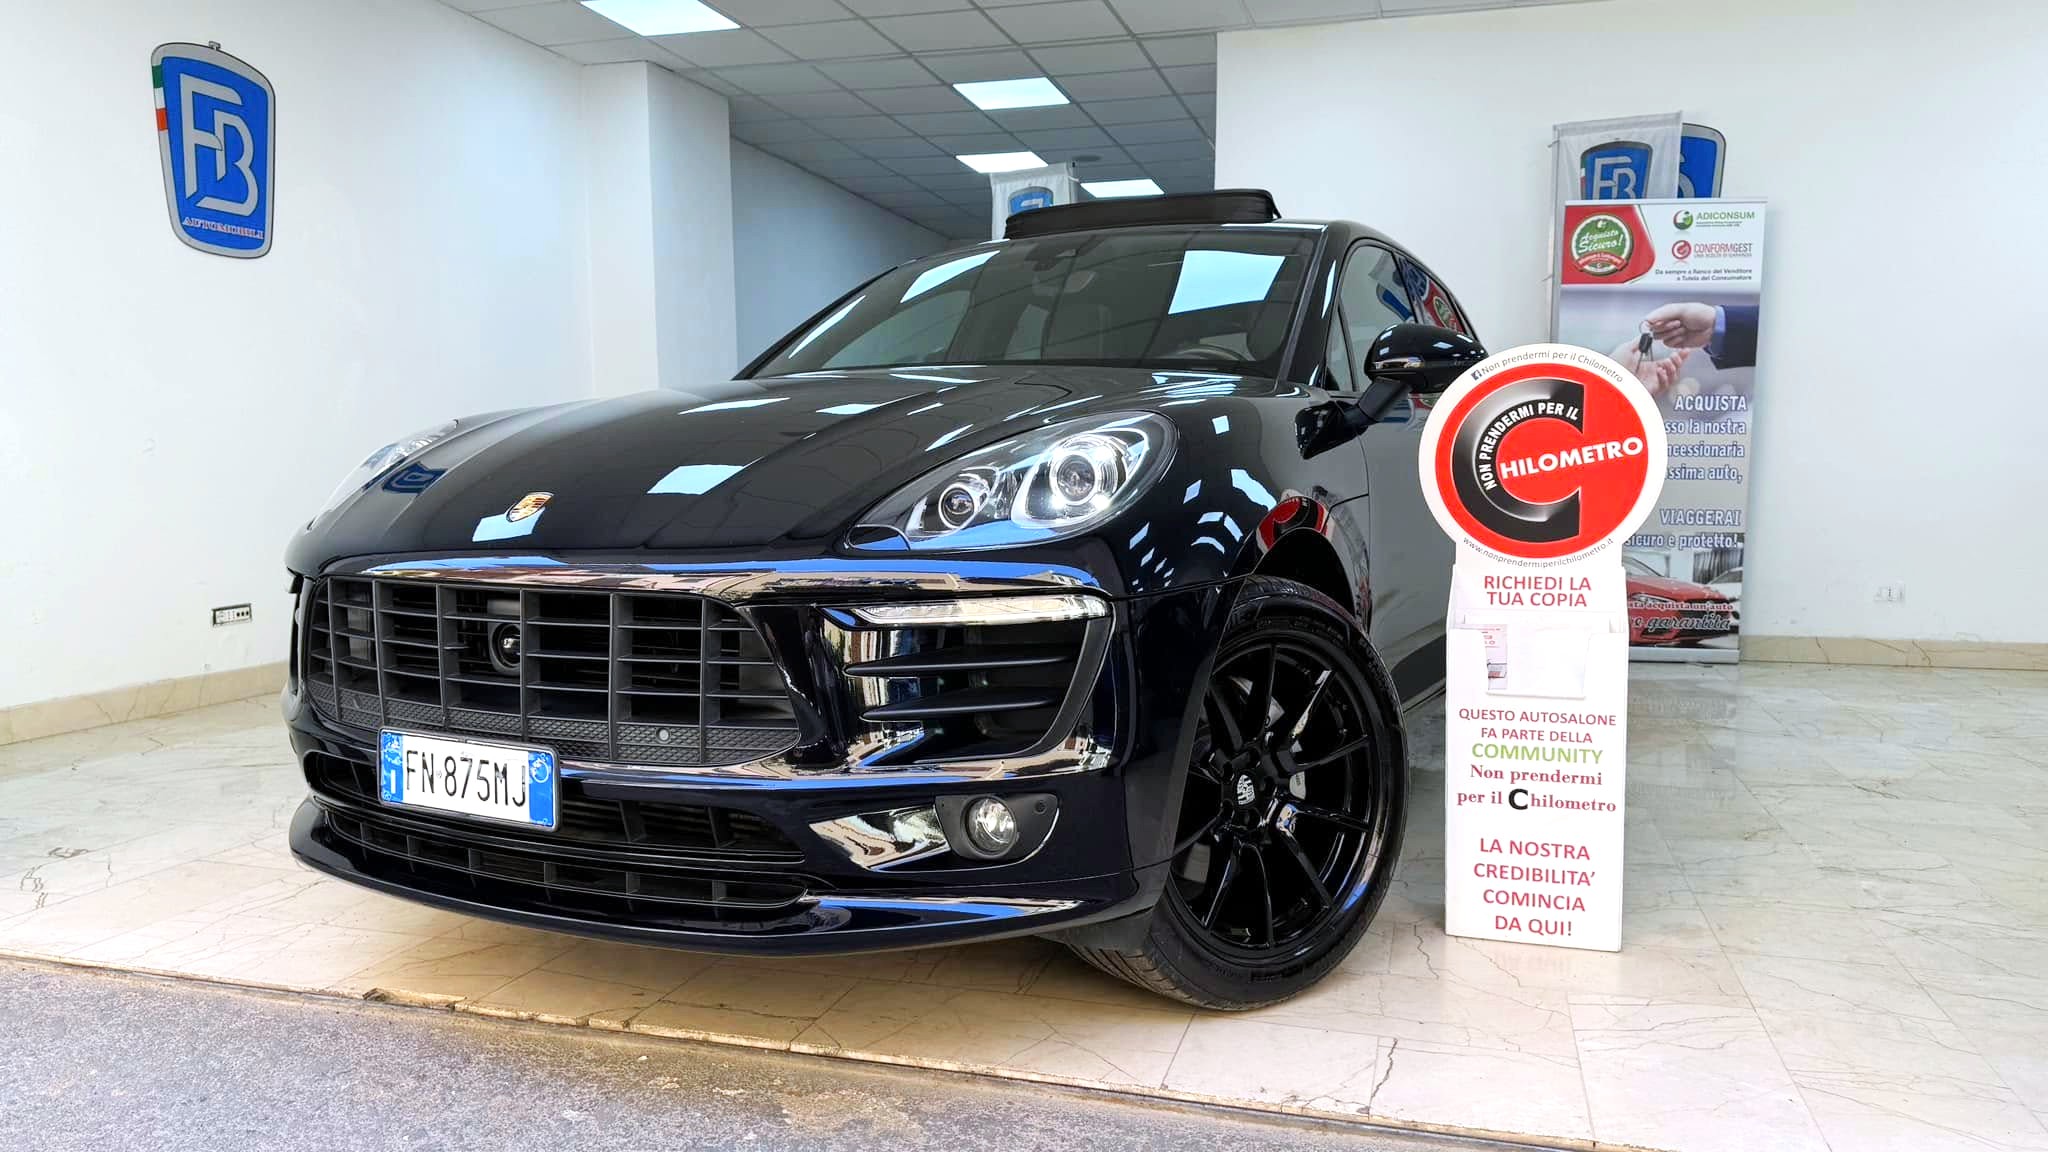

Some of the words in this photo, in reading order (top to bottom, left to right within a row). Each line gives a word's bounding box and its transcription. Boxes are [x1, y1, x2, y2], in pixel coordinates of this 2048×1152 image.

[1696, 211, 1755, 220] ADICONSUM
[1694, 243, 1753, 253] CONFORMGEST
[1482, 362, 1500, 375] Non
[1502, 351, 1550, 367] prendermi
[1552, 351, 1568, 360] per
[1570, 352, 1577, 361] il
[1578, 354, 1623, 383] Chilometro
[1538, 402, 1565, 415] PER
[1674, 395, 1747, 411] ACQUISTA
[1566, 406, 1579, 421] IL
[1479, 404, 1535, 460] PRENDERMI
[1665, 421, 1685, 434] sso
[1689, 418, 1700, 434] la
[1704, 418, 1746, 434] nostra
[1479, 463, 1498, 490] NON
[1666, 464, 1705, 480] ssima
[1709, 464, 1743, 483] auto,
[1660, 508, 1742, 526] VIAGGERAI
[1668, 536, 1676, 547] e
[1679, 534, 1738, 549] protetto!
[1463, 538, 1614, 568] www.nonprendermiperilchilometro.it
[1484, 575, 1563, 591] RICHIEDI
[1570, 577, 1592, 591] LA
[1487, 592, 1524, 606] TUA
[1530, 593, 1588, 607] COPIA
[1459, 708, 1515, 721] QUESTO
[1519, 711, 1617, 726] AUTOSALONE
[1481, 727, 1497, 739] FA
[1502, 728, 1545, 741] PARTE
[1550, 730, 1593, 743] DELLA
[1471, 743, 1603, 764] COMMUNITY
[406, 750, 435, 793] FN
[444, 756, 526, 807] 875MJ
[1470, 764, 1504, 780] Non
[1510, 768, 1603, 786] prendermi
[1457, 791, 1485, 806] per
[1491, 790, 1503, 804] il
[1508, 788, 1617, 812] Chilometro
[1480, 838, 1503, 854] LA
[1509, 840, 1591, 861] NOSTRA
[1473, 863, 1595, 887] CREDIBILITA'
[1483, 889, 1586, 912] COMINCIA
[1495, 915, 1522, 932] DA
[1528, 918, 1572, 937] QUI!
